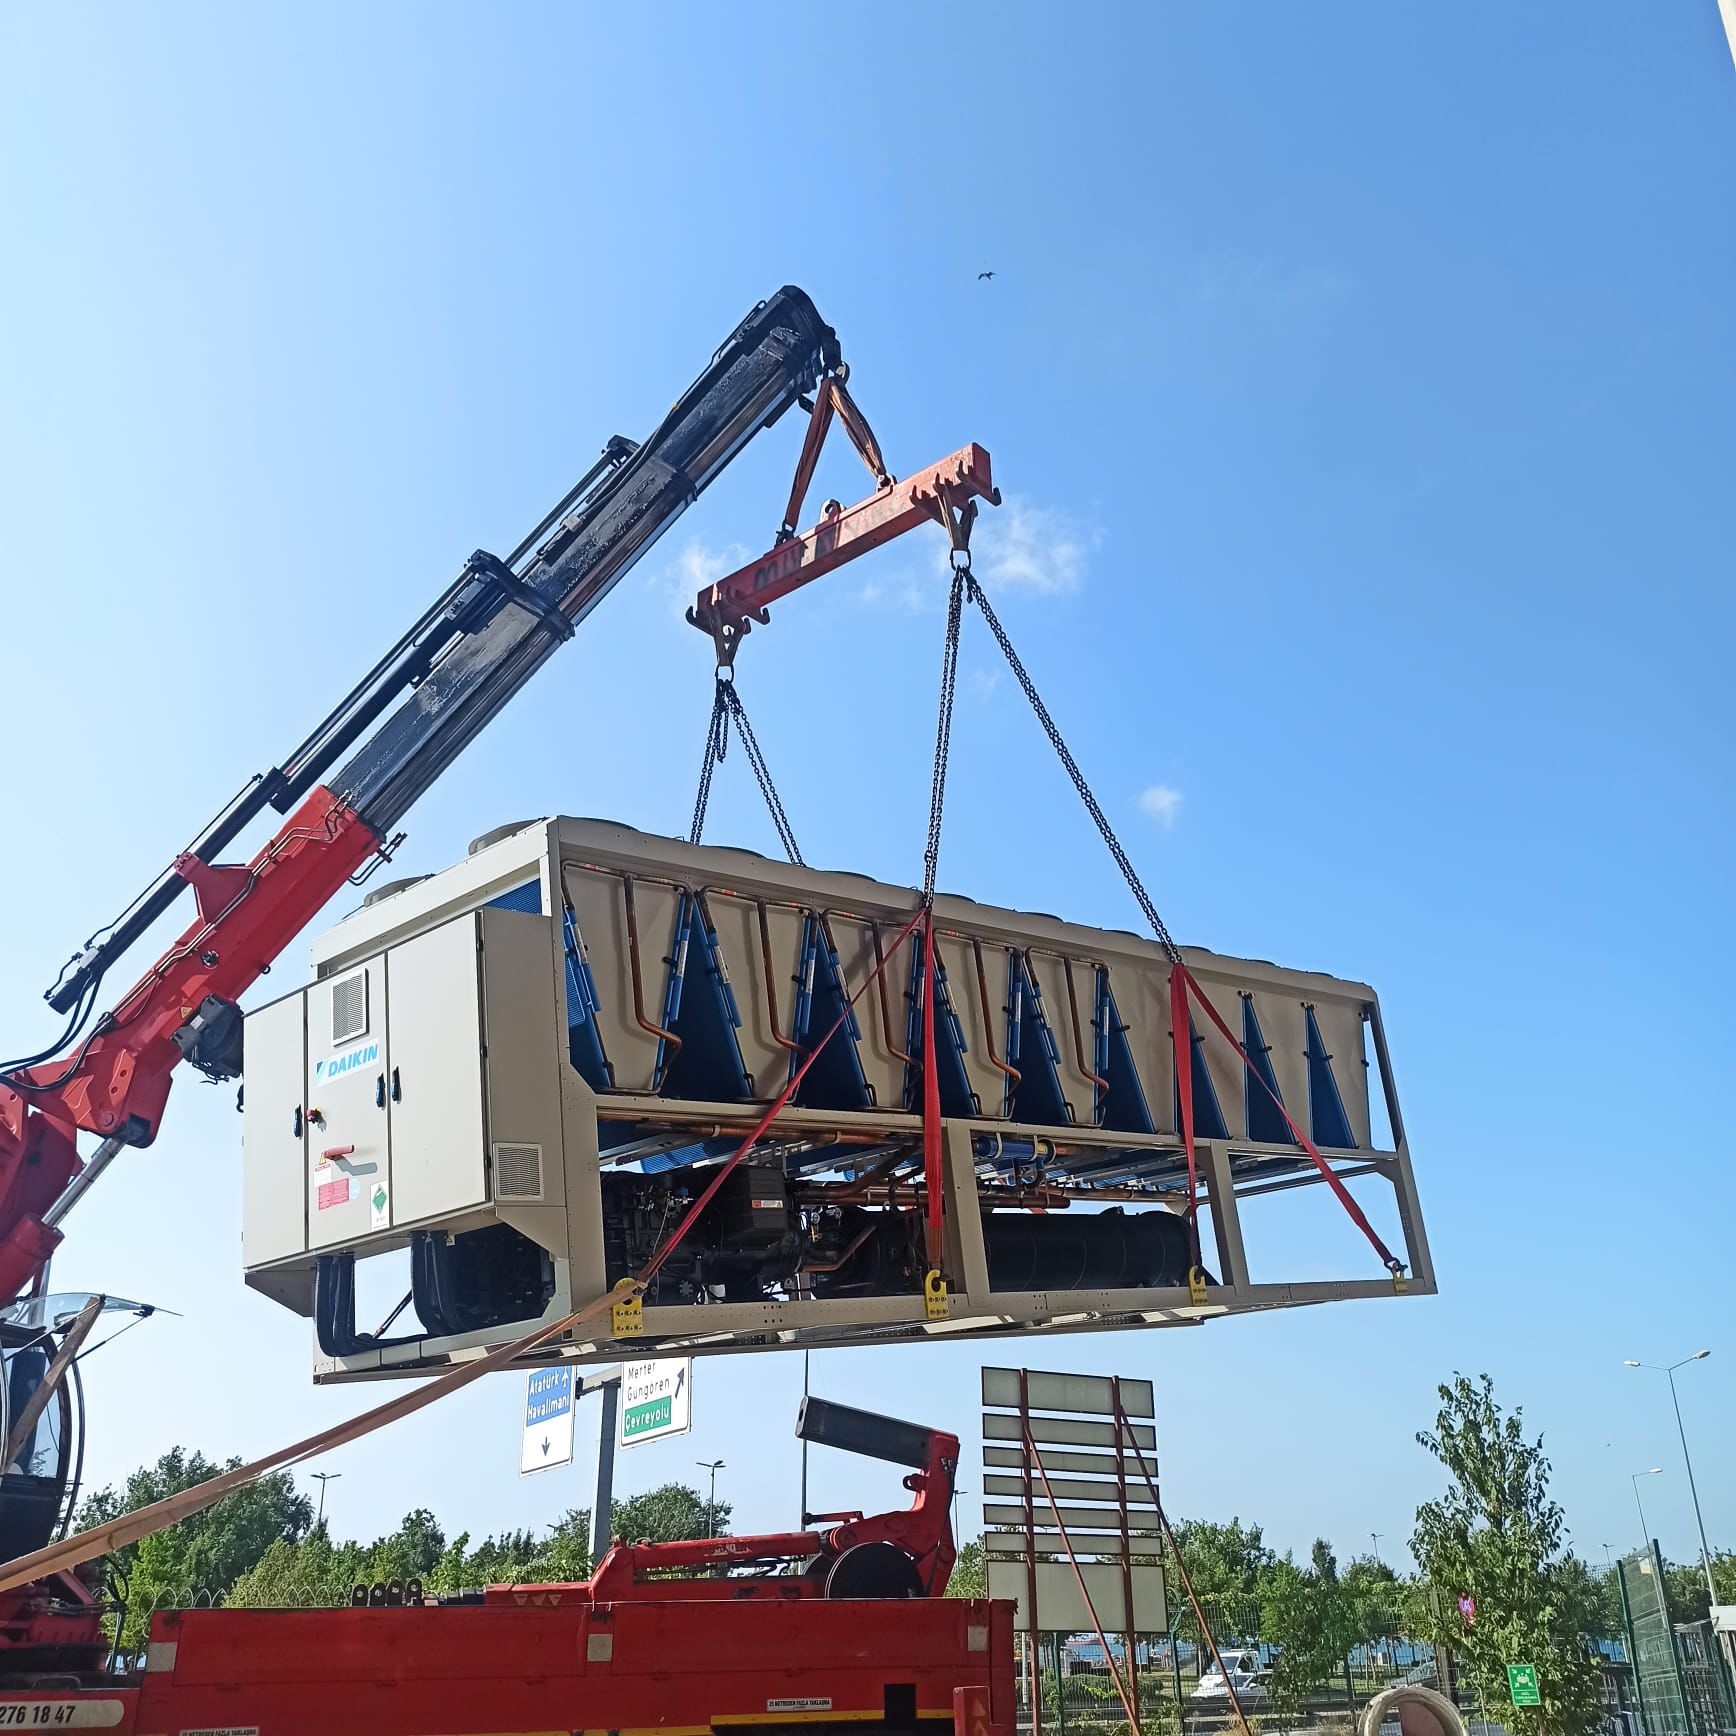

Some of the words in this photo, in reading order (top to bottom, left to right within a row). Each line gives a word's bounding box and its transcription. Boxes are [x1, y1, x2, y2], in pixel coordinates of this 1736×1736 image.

[328, 1044, 378, 1077] DAIKIN
[529, 1370, 560, 1396] Atatürk
[628, 1362, 656, 1380] Merter
[625, 1403, 669, 1432] Çevreyolu
[33, 1705, 51, 1724] 18
[54, 1705, 76, 1724] 47
